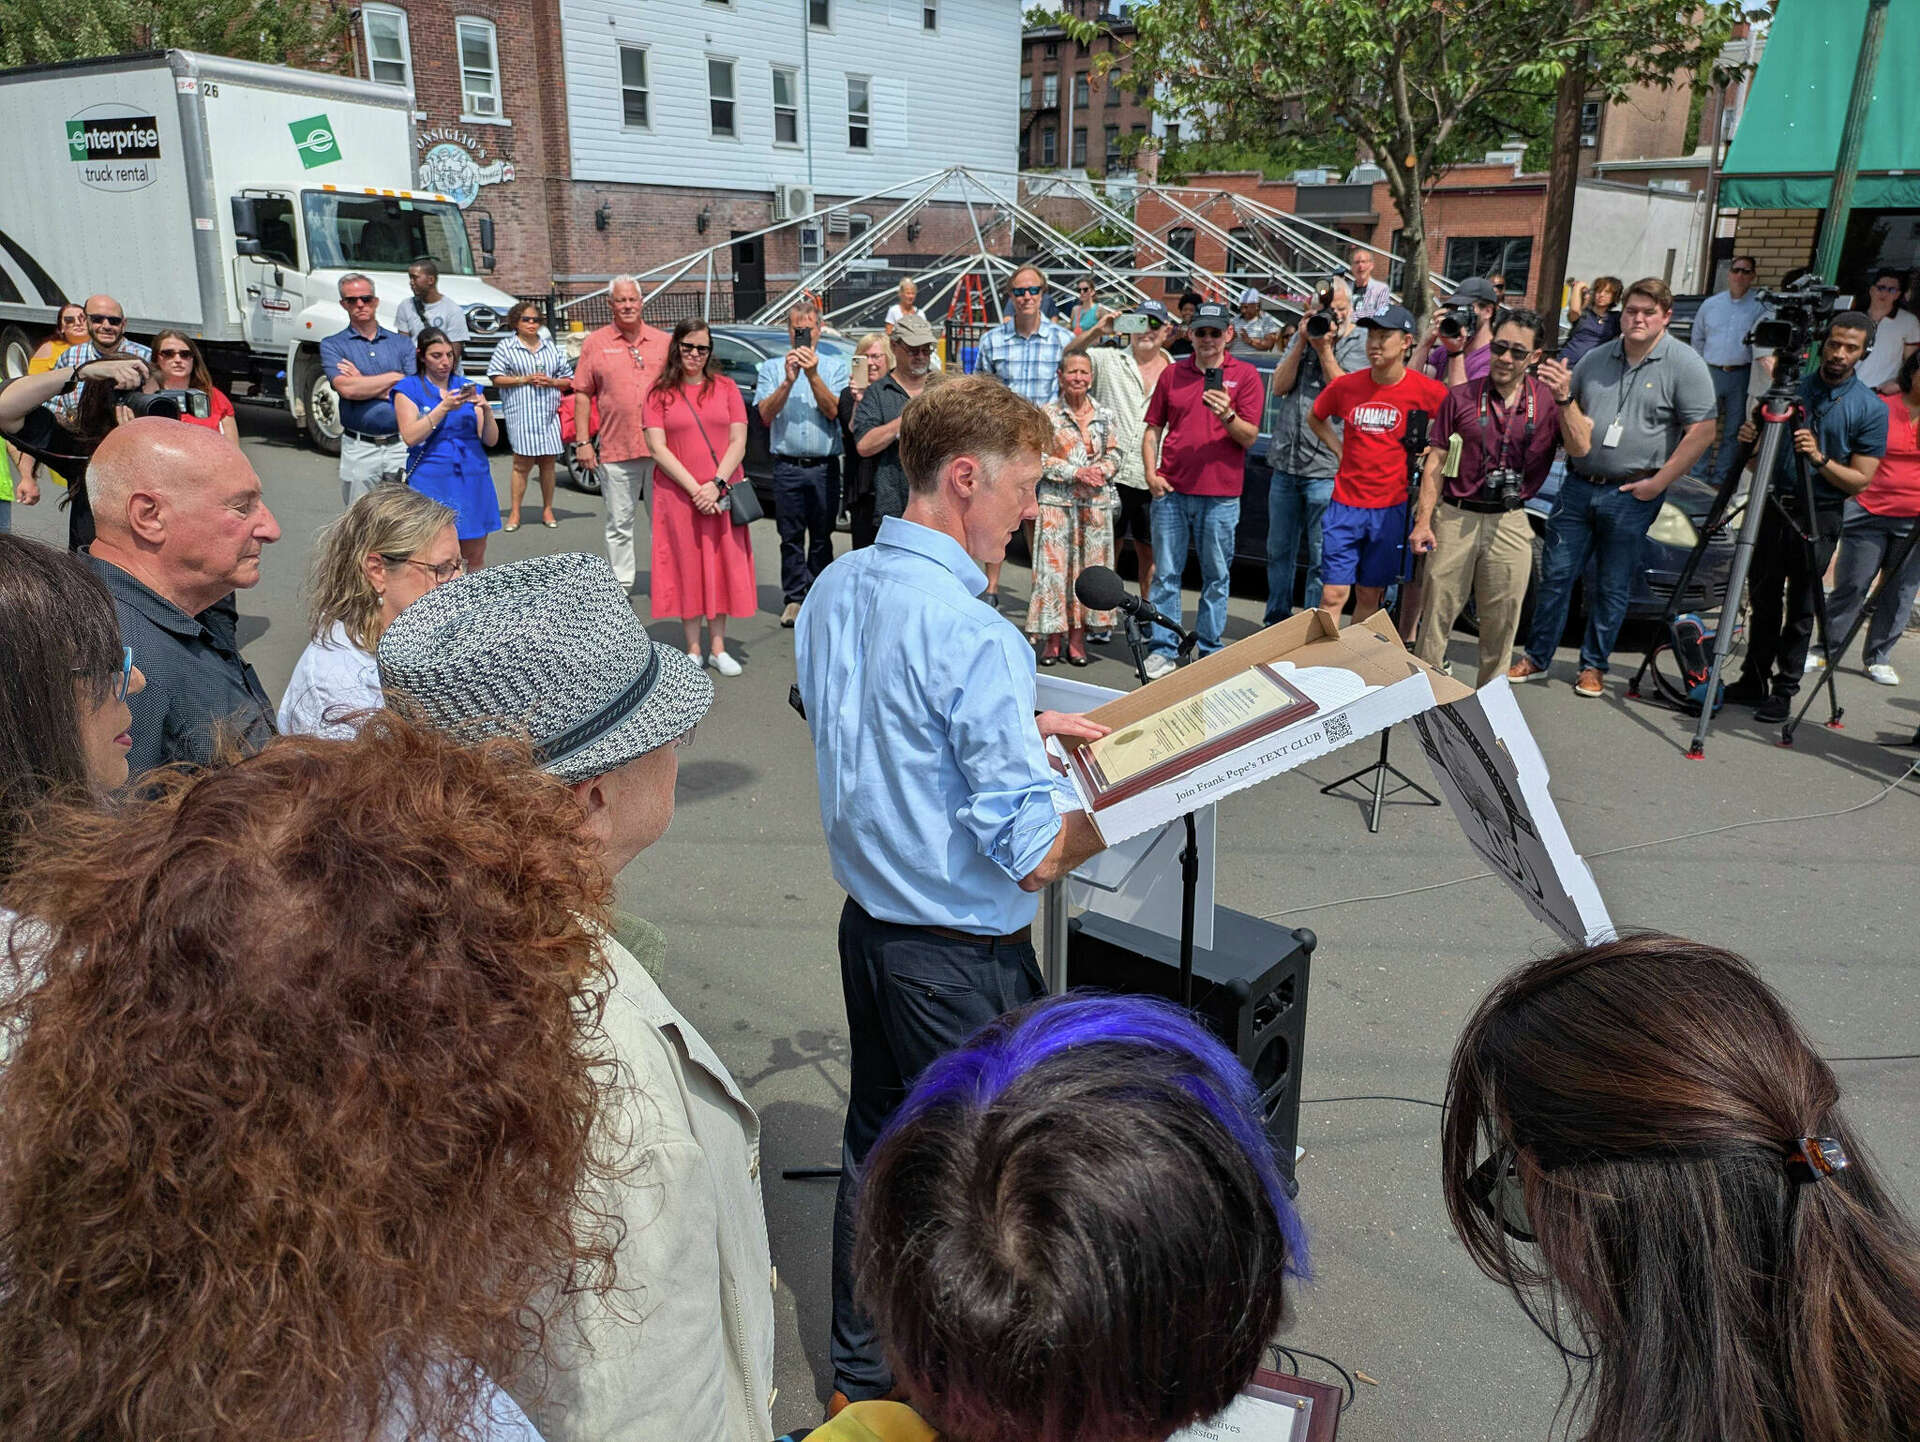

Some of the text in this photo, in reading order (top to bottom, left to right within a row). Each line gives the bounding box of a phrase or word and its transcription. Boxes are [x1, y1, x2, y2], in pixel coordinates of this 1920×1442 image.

[203, 82, 219, 98] 26
[68, 123, 158, 155] enterprise
[415, 127, 488, 160] ONSIGLIO'S
[85, 162, 149, 182] truck rental
[1175, 732, 1322, 803] Join Frank Pepe's TEXT CLUB
